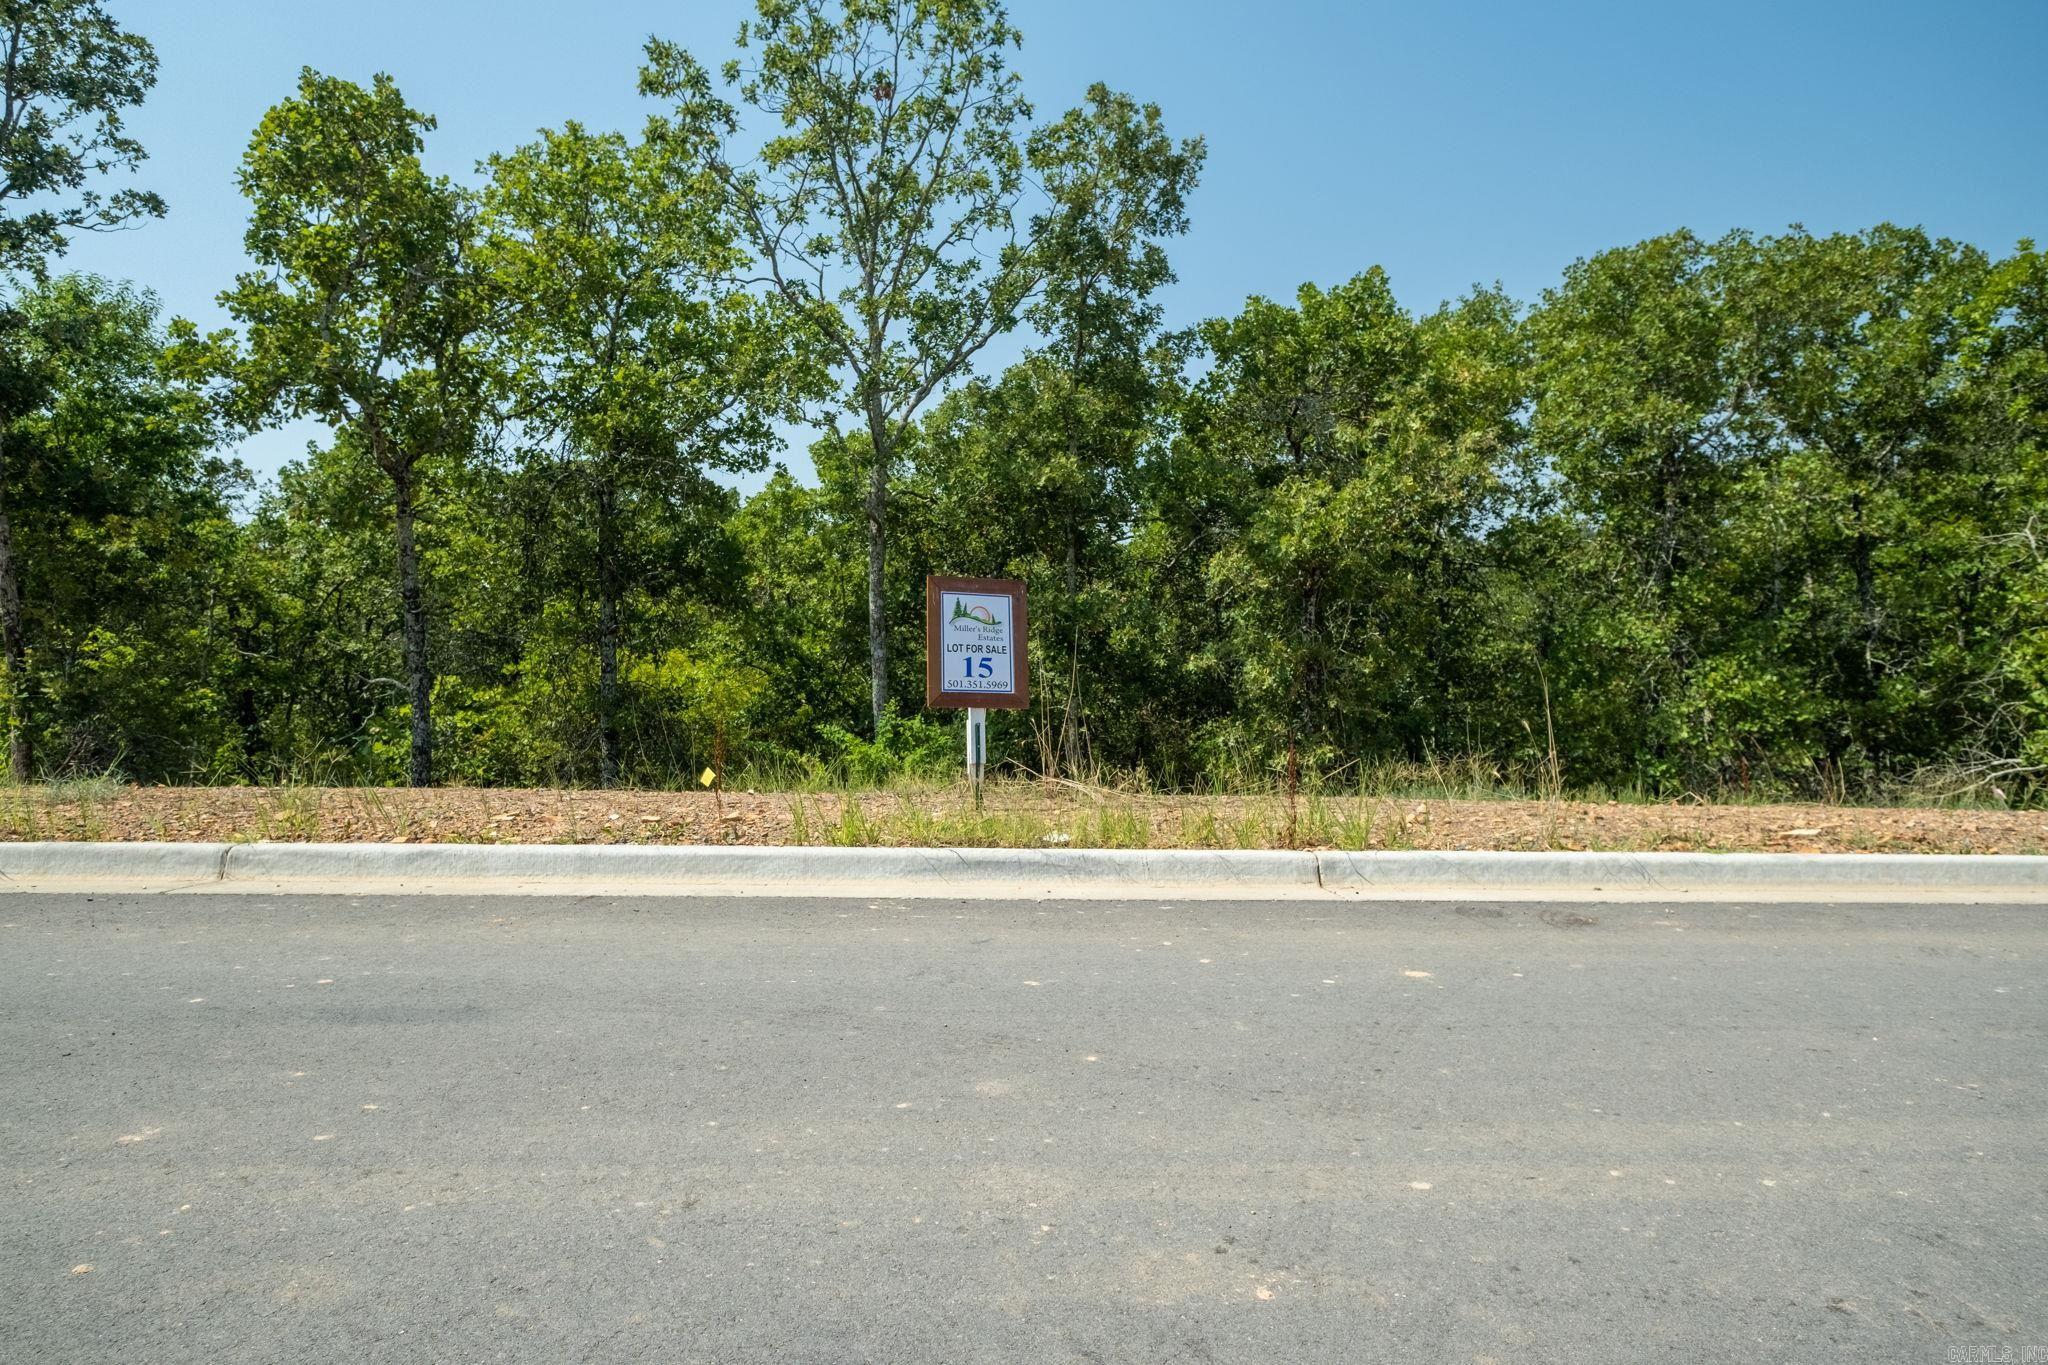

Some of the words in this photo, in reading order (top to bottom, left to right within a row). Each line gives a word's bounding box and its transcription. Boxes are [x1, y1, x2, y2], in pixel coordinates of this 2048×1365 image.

[982, 626, 1003, 635] Ridge
[947, 644, 964, 652] LOT
[966, 645, 983, 653] FOR
[985, 645, 1007, 654] SALE
[963, 656, 993, 678] 15
[947, 680, 1008, 689] 501.351.5969
